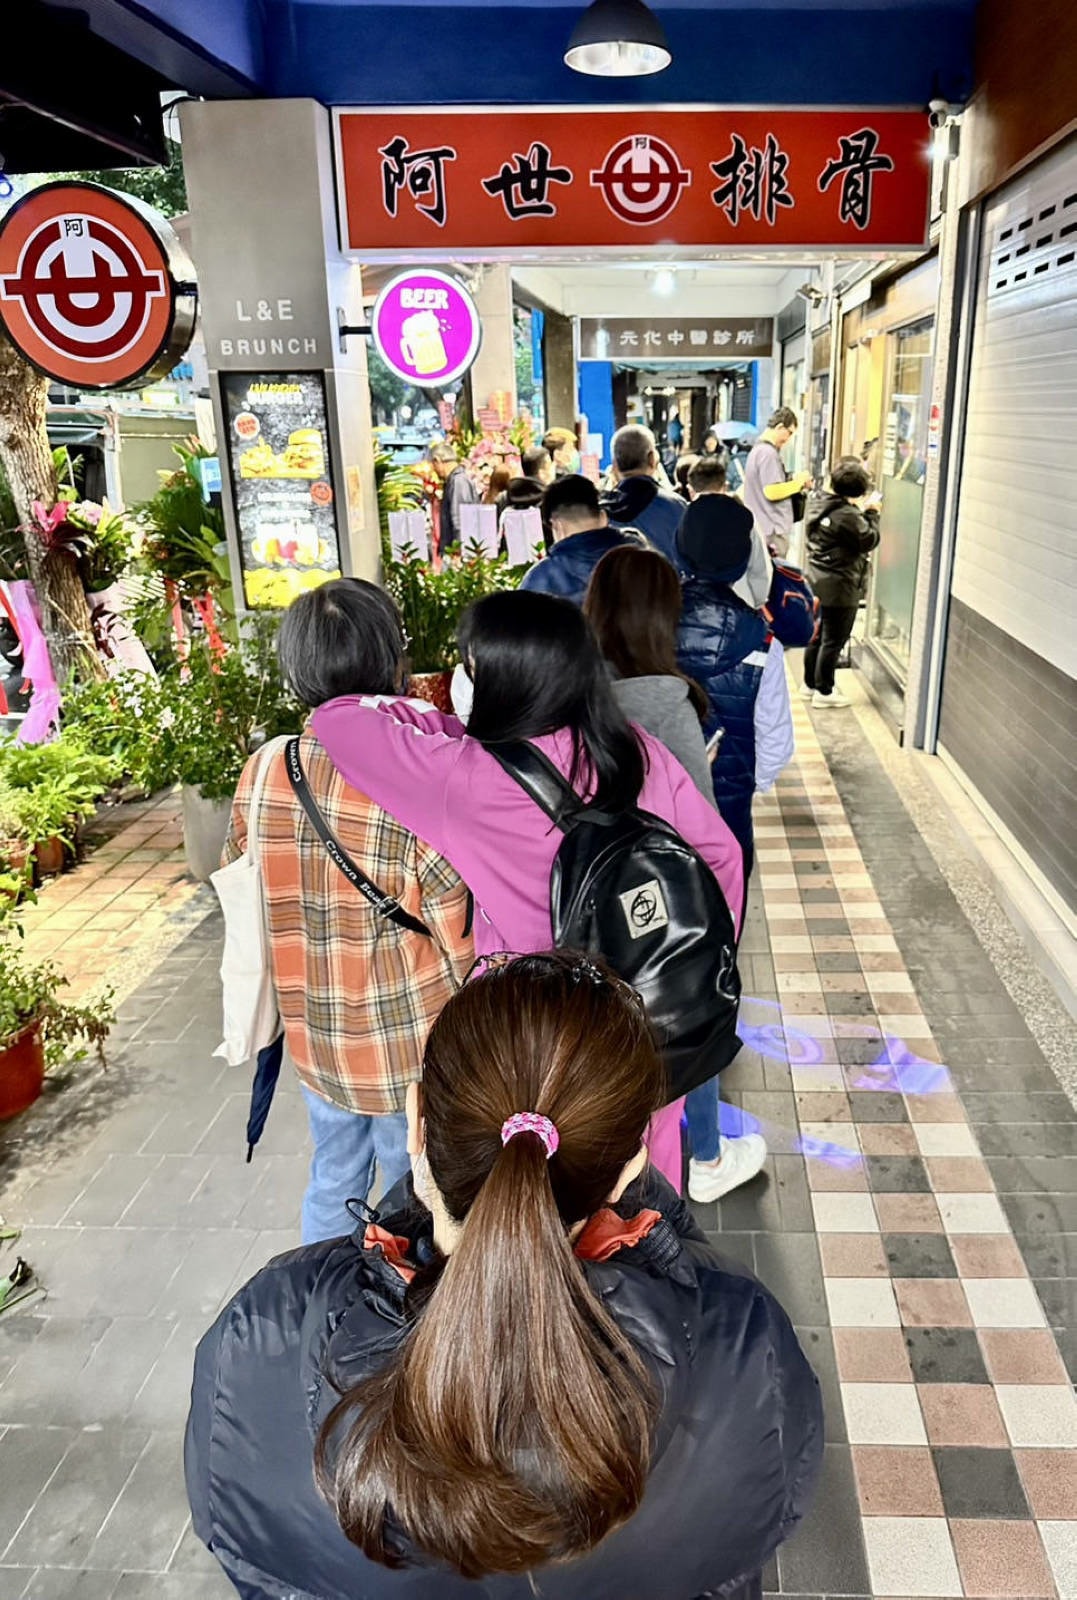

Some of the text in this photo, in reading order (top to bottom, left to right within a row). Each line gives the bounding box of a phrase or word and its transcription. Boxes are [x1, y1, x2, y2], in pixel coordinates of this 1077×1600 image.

[64, 218, 84, 237] 阿
[399, 287, 450, 310] BEER
[236, 299, 294, 321] L&E
[220, 338, 317, 356] BRUNCH
[619, 329, 756, 346] 元化中醫診所
[290, 741, 302, 782] Crown
[326, 840, 358, 880] Crown
